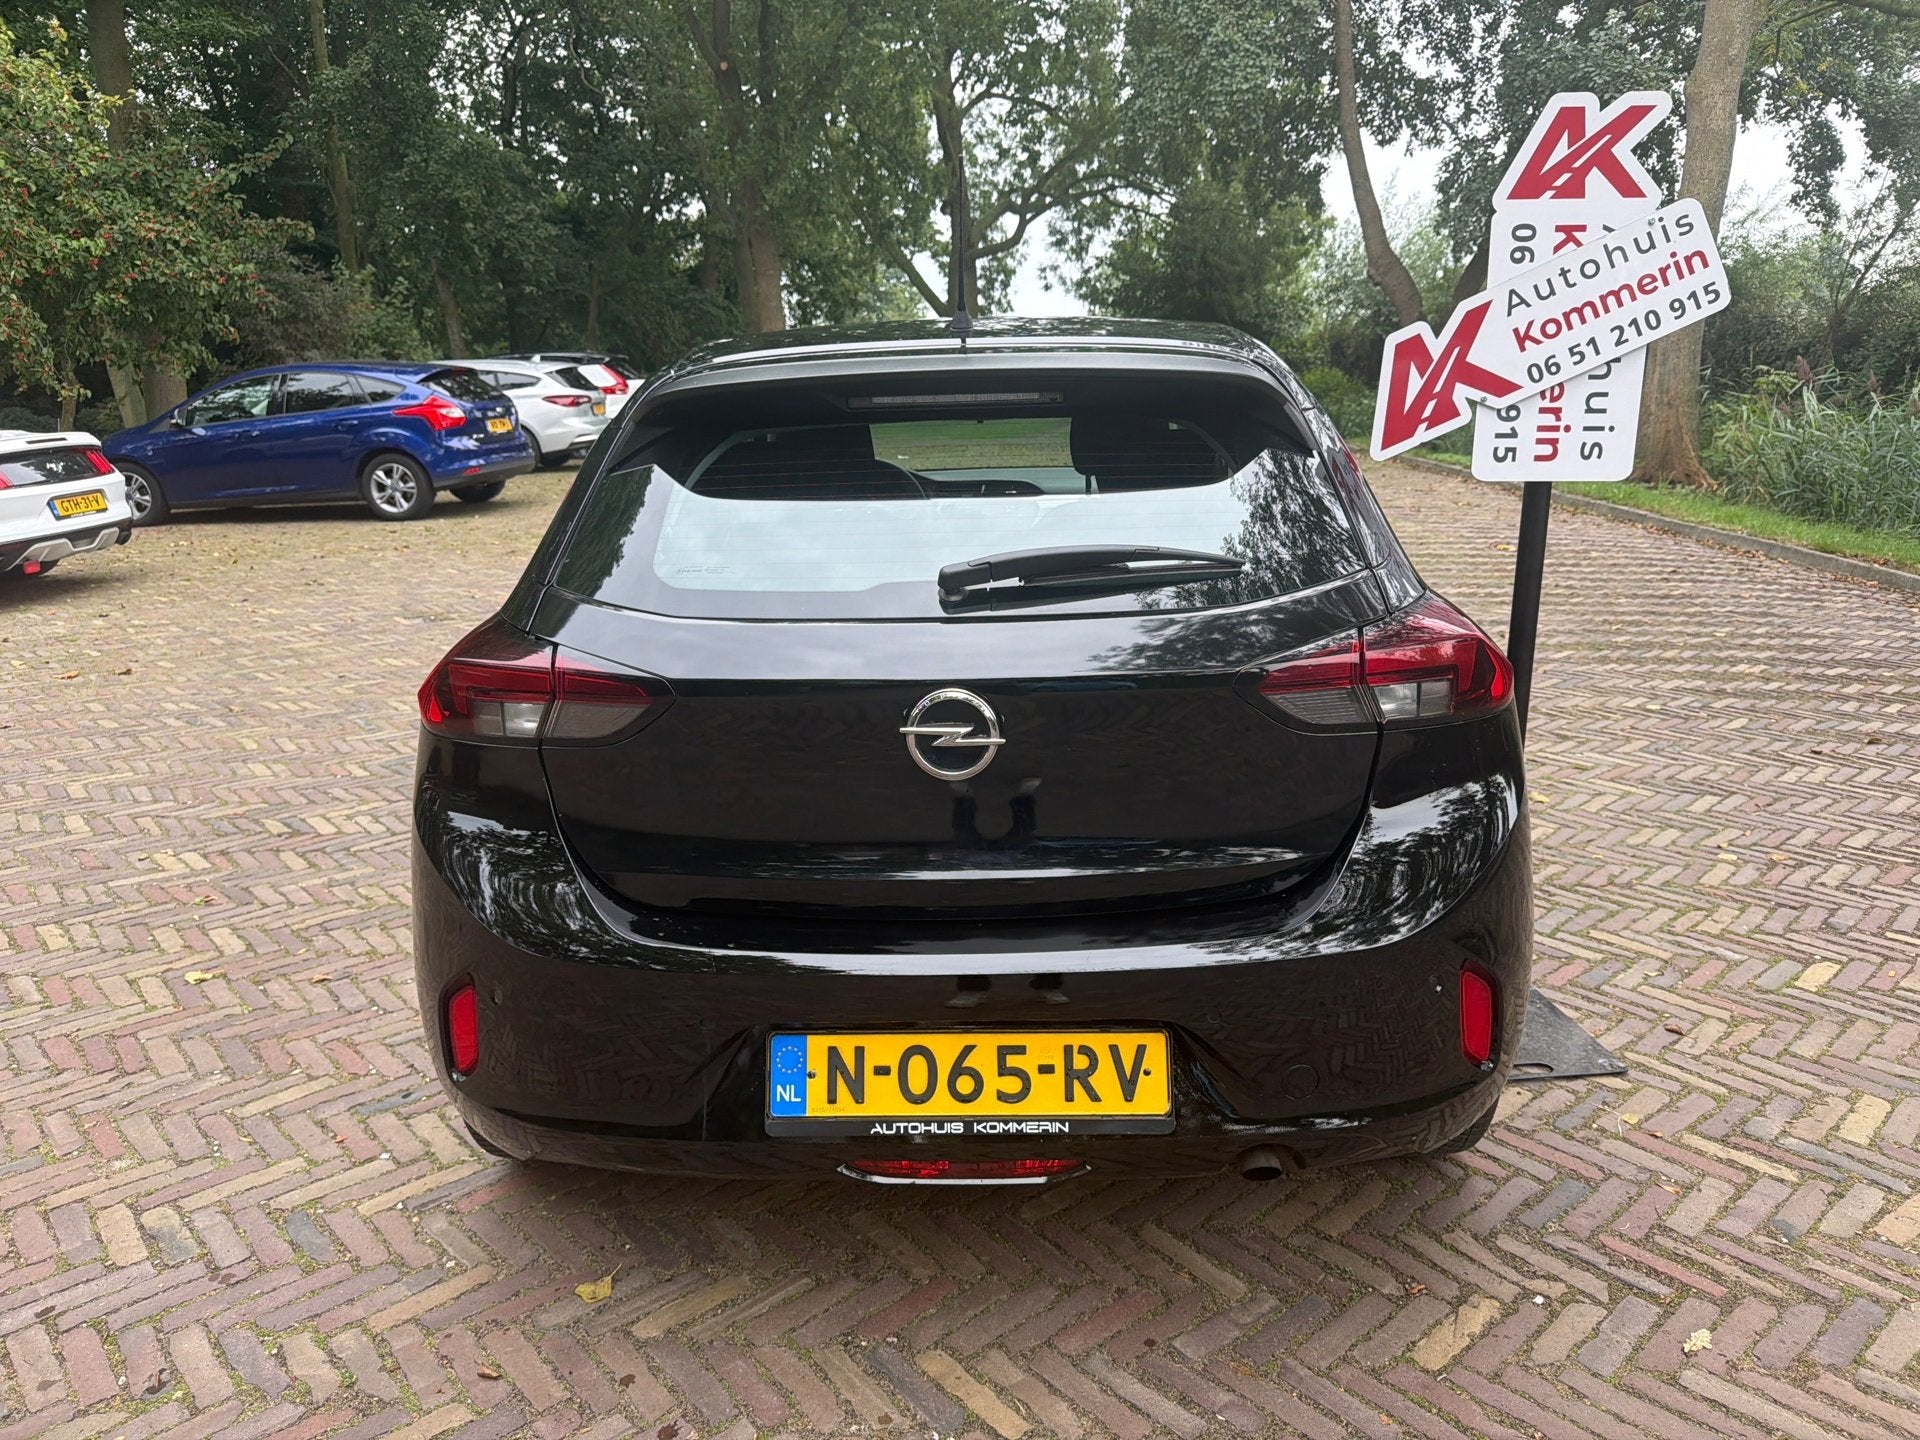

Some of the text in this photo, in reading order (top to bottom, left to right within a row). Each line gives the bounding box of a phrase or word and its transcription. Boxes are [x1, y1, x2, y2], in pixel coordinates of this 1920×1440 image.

[1507, 105, 1658, 199] AK
[1507, 214, 1695, 318] Autohuis
[1510, 223, 1537, 264] 06
[1512, 250, 1710, 353] Kommerin
[1527, 281, 1721, 384] 06 51 210 915
[1381, 299, 1525, 451] AK
[1493, 404, 1521, 463] 915
[60, 494, 100, 513] GTH-31-V
[776, 1084, 801, 1102] NL
[827, 1044, 1147, 1105] N-065-RV
[870, 1121, 1069, 1134] AUTOHUIS KOMMERIN
